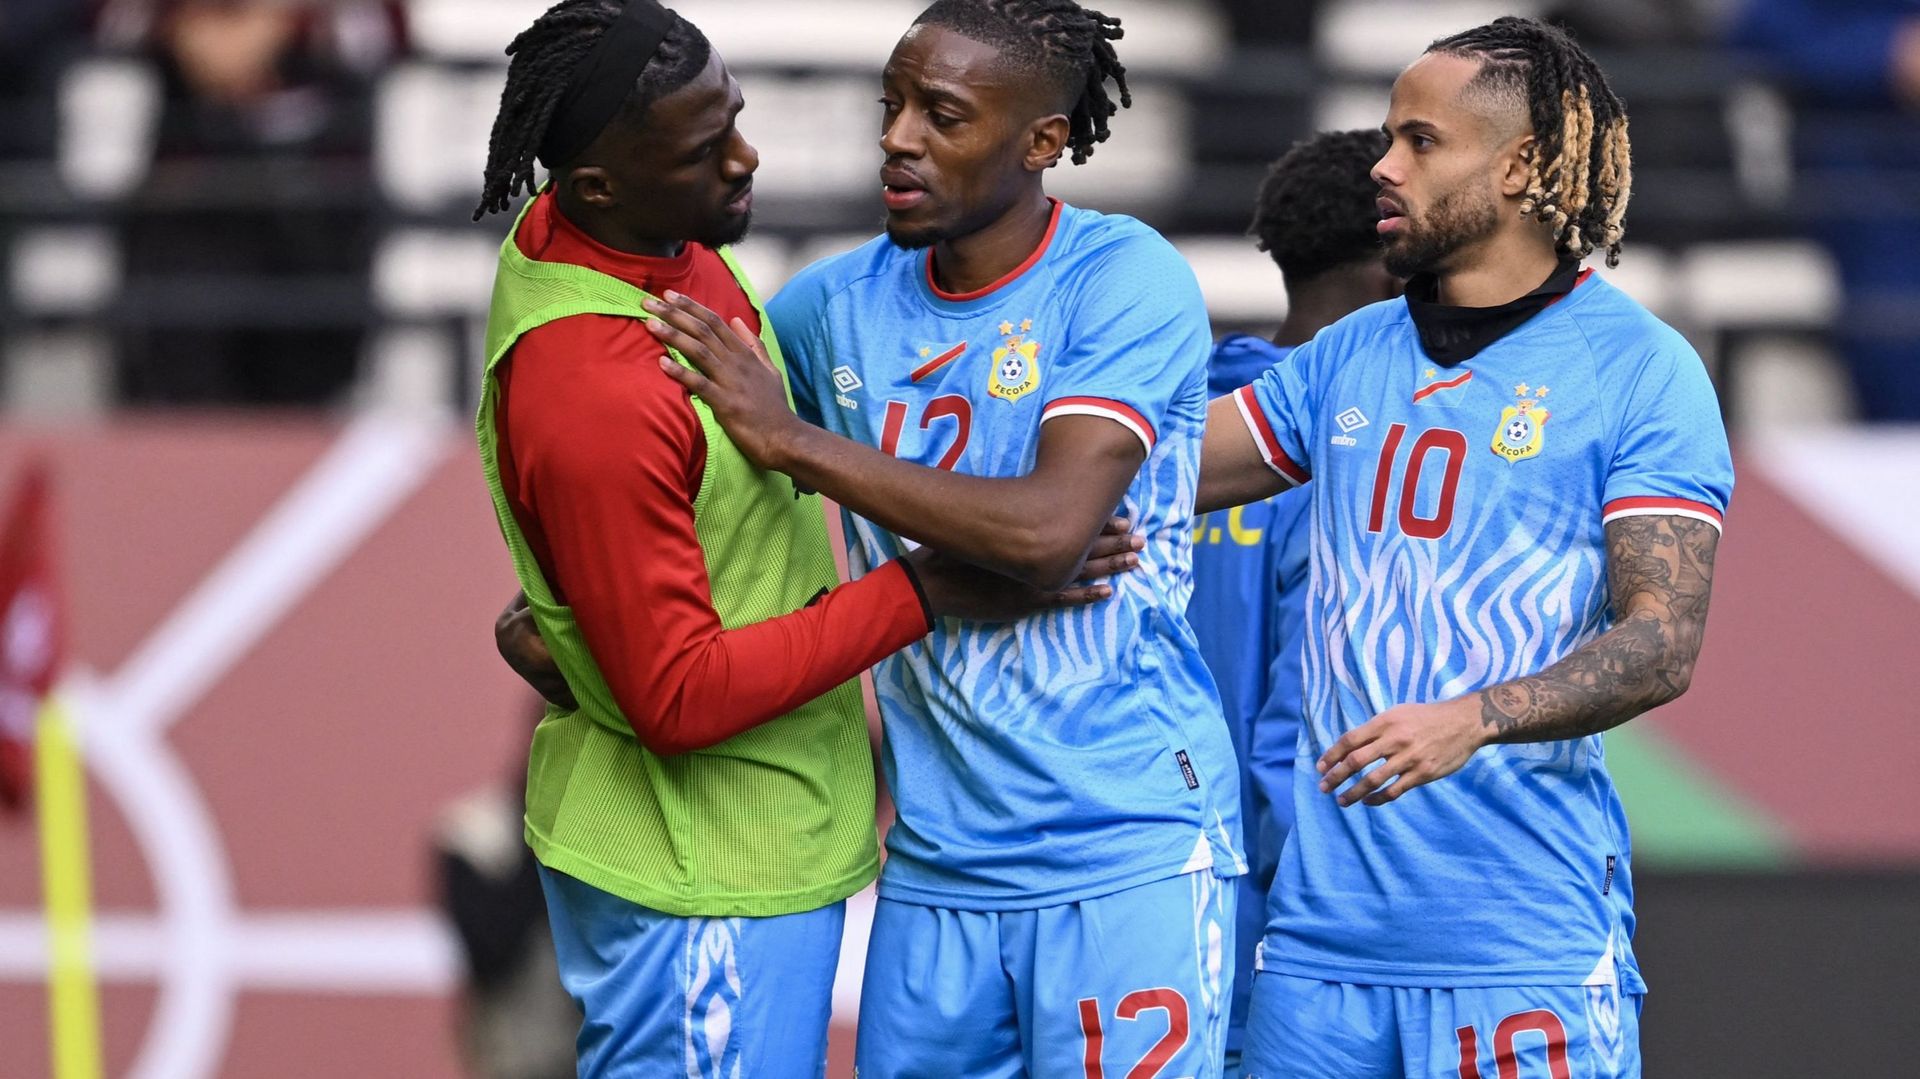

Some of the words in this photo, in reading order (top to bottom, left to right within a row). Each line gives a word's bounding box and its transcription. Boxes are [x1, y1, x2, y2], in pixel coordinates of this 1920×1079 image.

[836, 393, 858, 410] mbro
[994, 380, 1032, 396] FECOFA
[879, 394, 973, 472] 12
[1330, 434, 1357, 448] umbro
[1496, 441, 1533, 456] FECOFA
[1367, 422, 1469, 541] 10
[1077, 986, 1195, 1079] 12
[1455, 1008, 1572, 1079] 10
